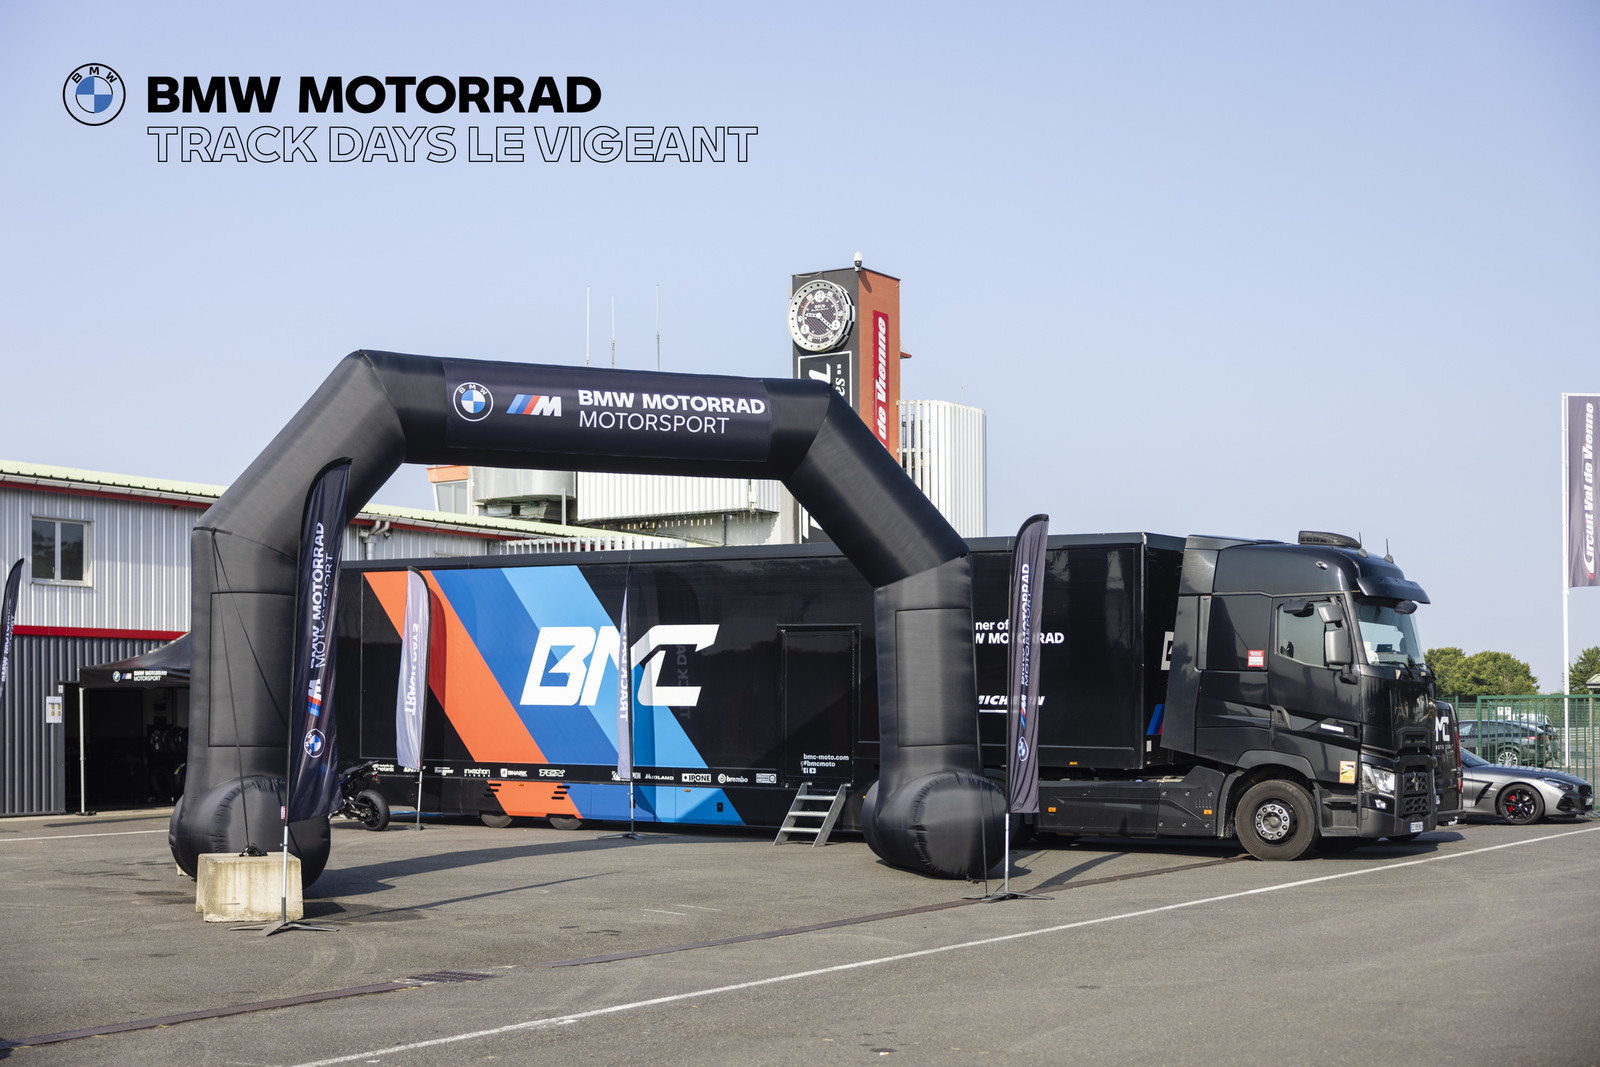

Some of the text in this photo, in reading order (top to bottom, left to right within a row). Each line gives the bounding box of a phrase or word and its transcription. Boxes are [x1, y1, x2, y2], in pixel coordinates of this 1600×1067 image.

[875, 316, 887, 403] Vienne
[577, 389, 766, 415] BMW MOTORRAD
[579, 410, 730, 434] MOTORSPORT
[877, 405, 887, 441] de
[1582, 403, 1595, 579] Circuit Val de Vienne
[312, 522, 325, 620] MOTORRAD
[996, 619, 1010, 631] of
[519, 624, 720, 706] BMC
[803, 753, 850, 761] bmc-moto.com
[688, 774, 712, 783] IPONE
[726, 775, 749, 783] brembo
